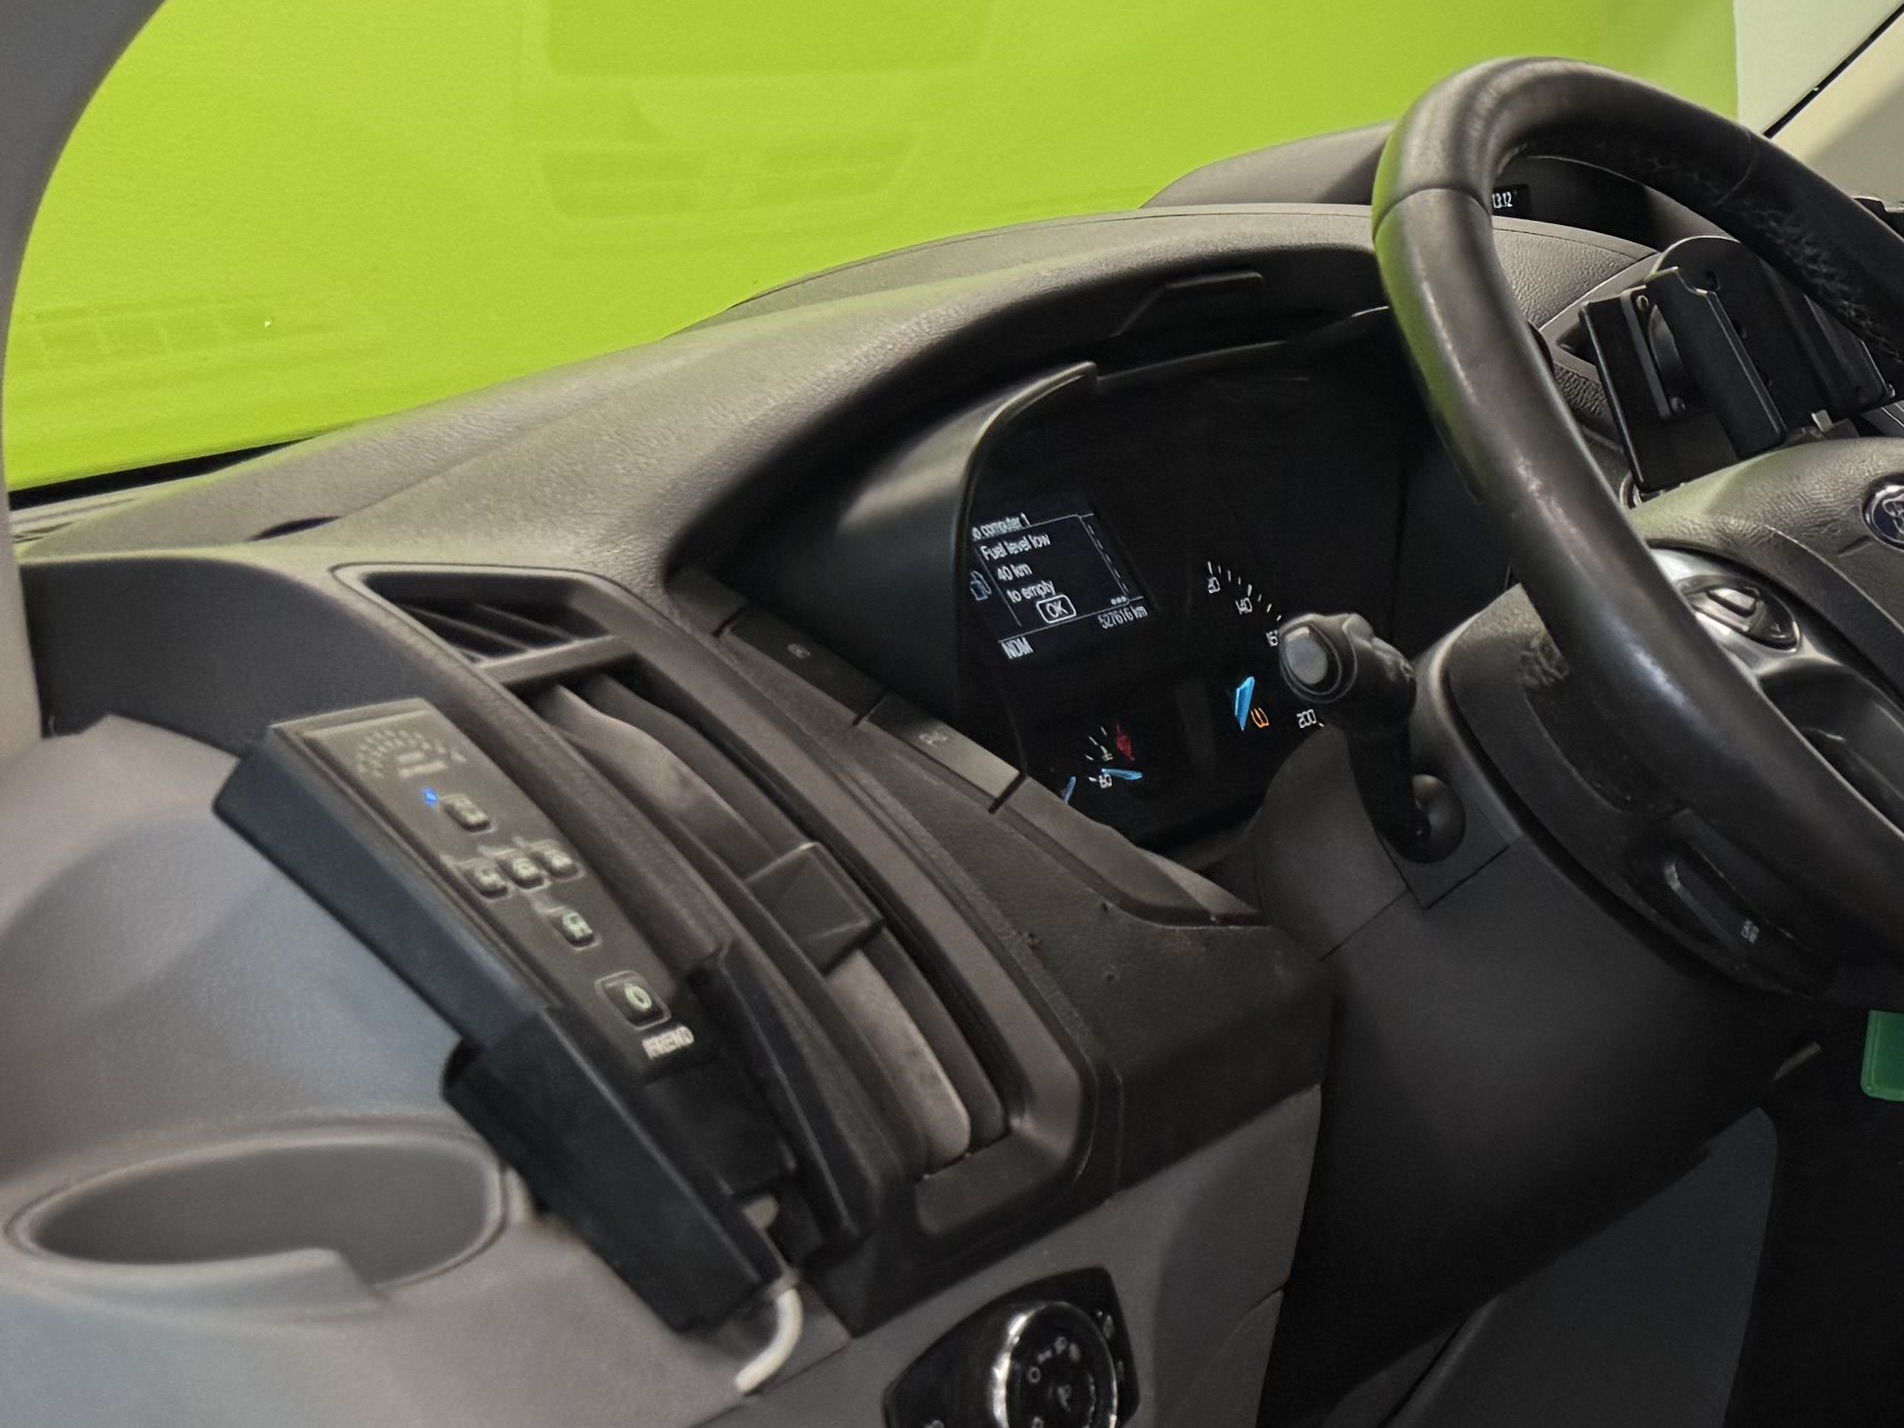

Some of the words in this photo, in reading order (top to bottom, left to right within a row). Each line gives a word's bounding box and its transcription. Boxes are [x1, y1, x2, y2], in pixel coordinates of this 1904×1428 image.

[980, 542, 1008, 561] Fuel
[1003, 535, 1032, 555] level
[1028, 532, 1051, 549] low
[996, 565, 1014, 582] 40
[1013, 562, 1033, 578] km
[1006, 589, 1022, 604] to
[1021, 580, 1056, 600] empty
[1046, 600, 1069, 618] OK
